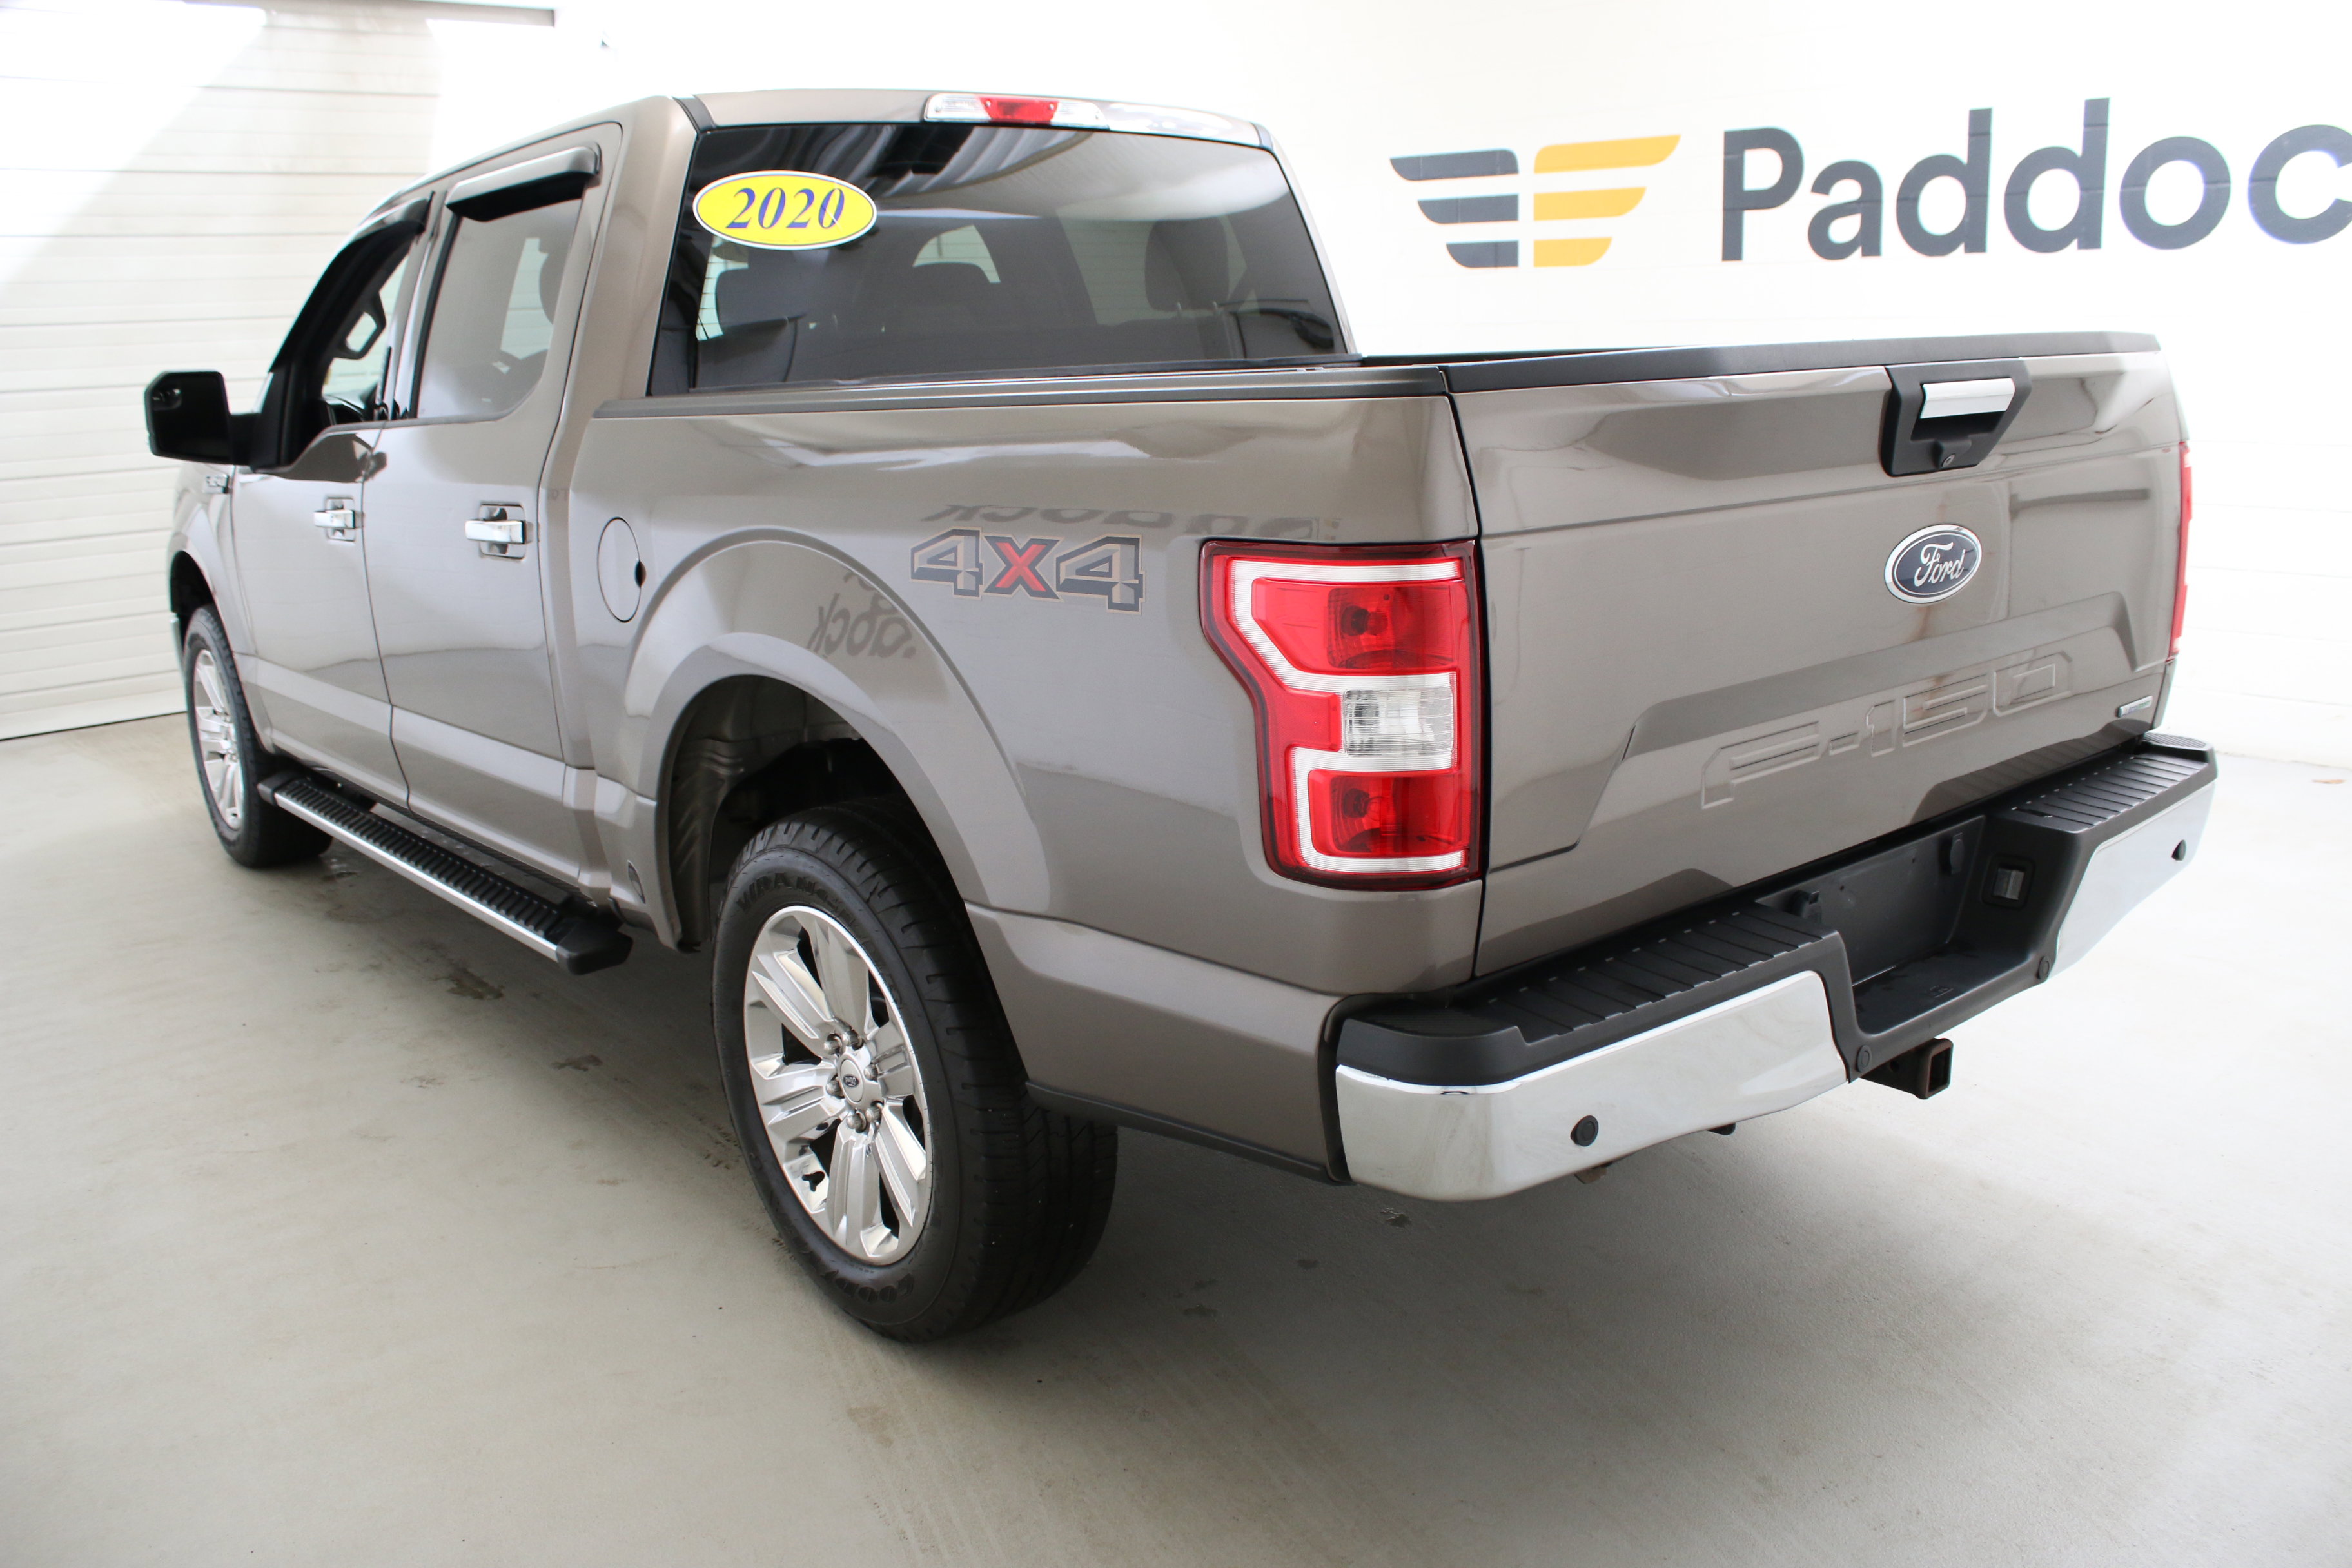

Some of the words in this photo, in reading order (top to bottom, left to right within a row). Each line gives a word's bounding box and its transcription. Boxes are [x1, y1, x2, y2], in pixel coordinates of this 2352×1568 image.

[725, 187, 845, 230] 2020
[1722, 97, 2352, 262] Paddoc
[1914, 542, 1966, 587] Ford
[1701, 651, 2073, 810] F-150
